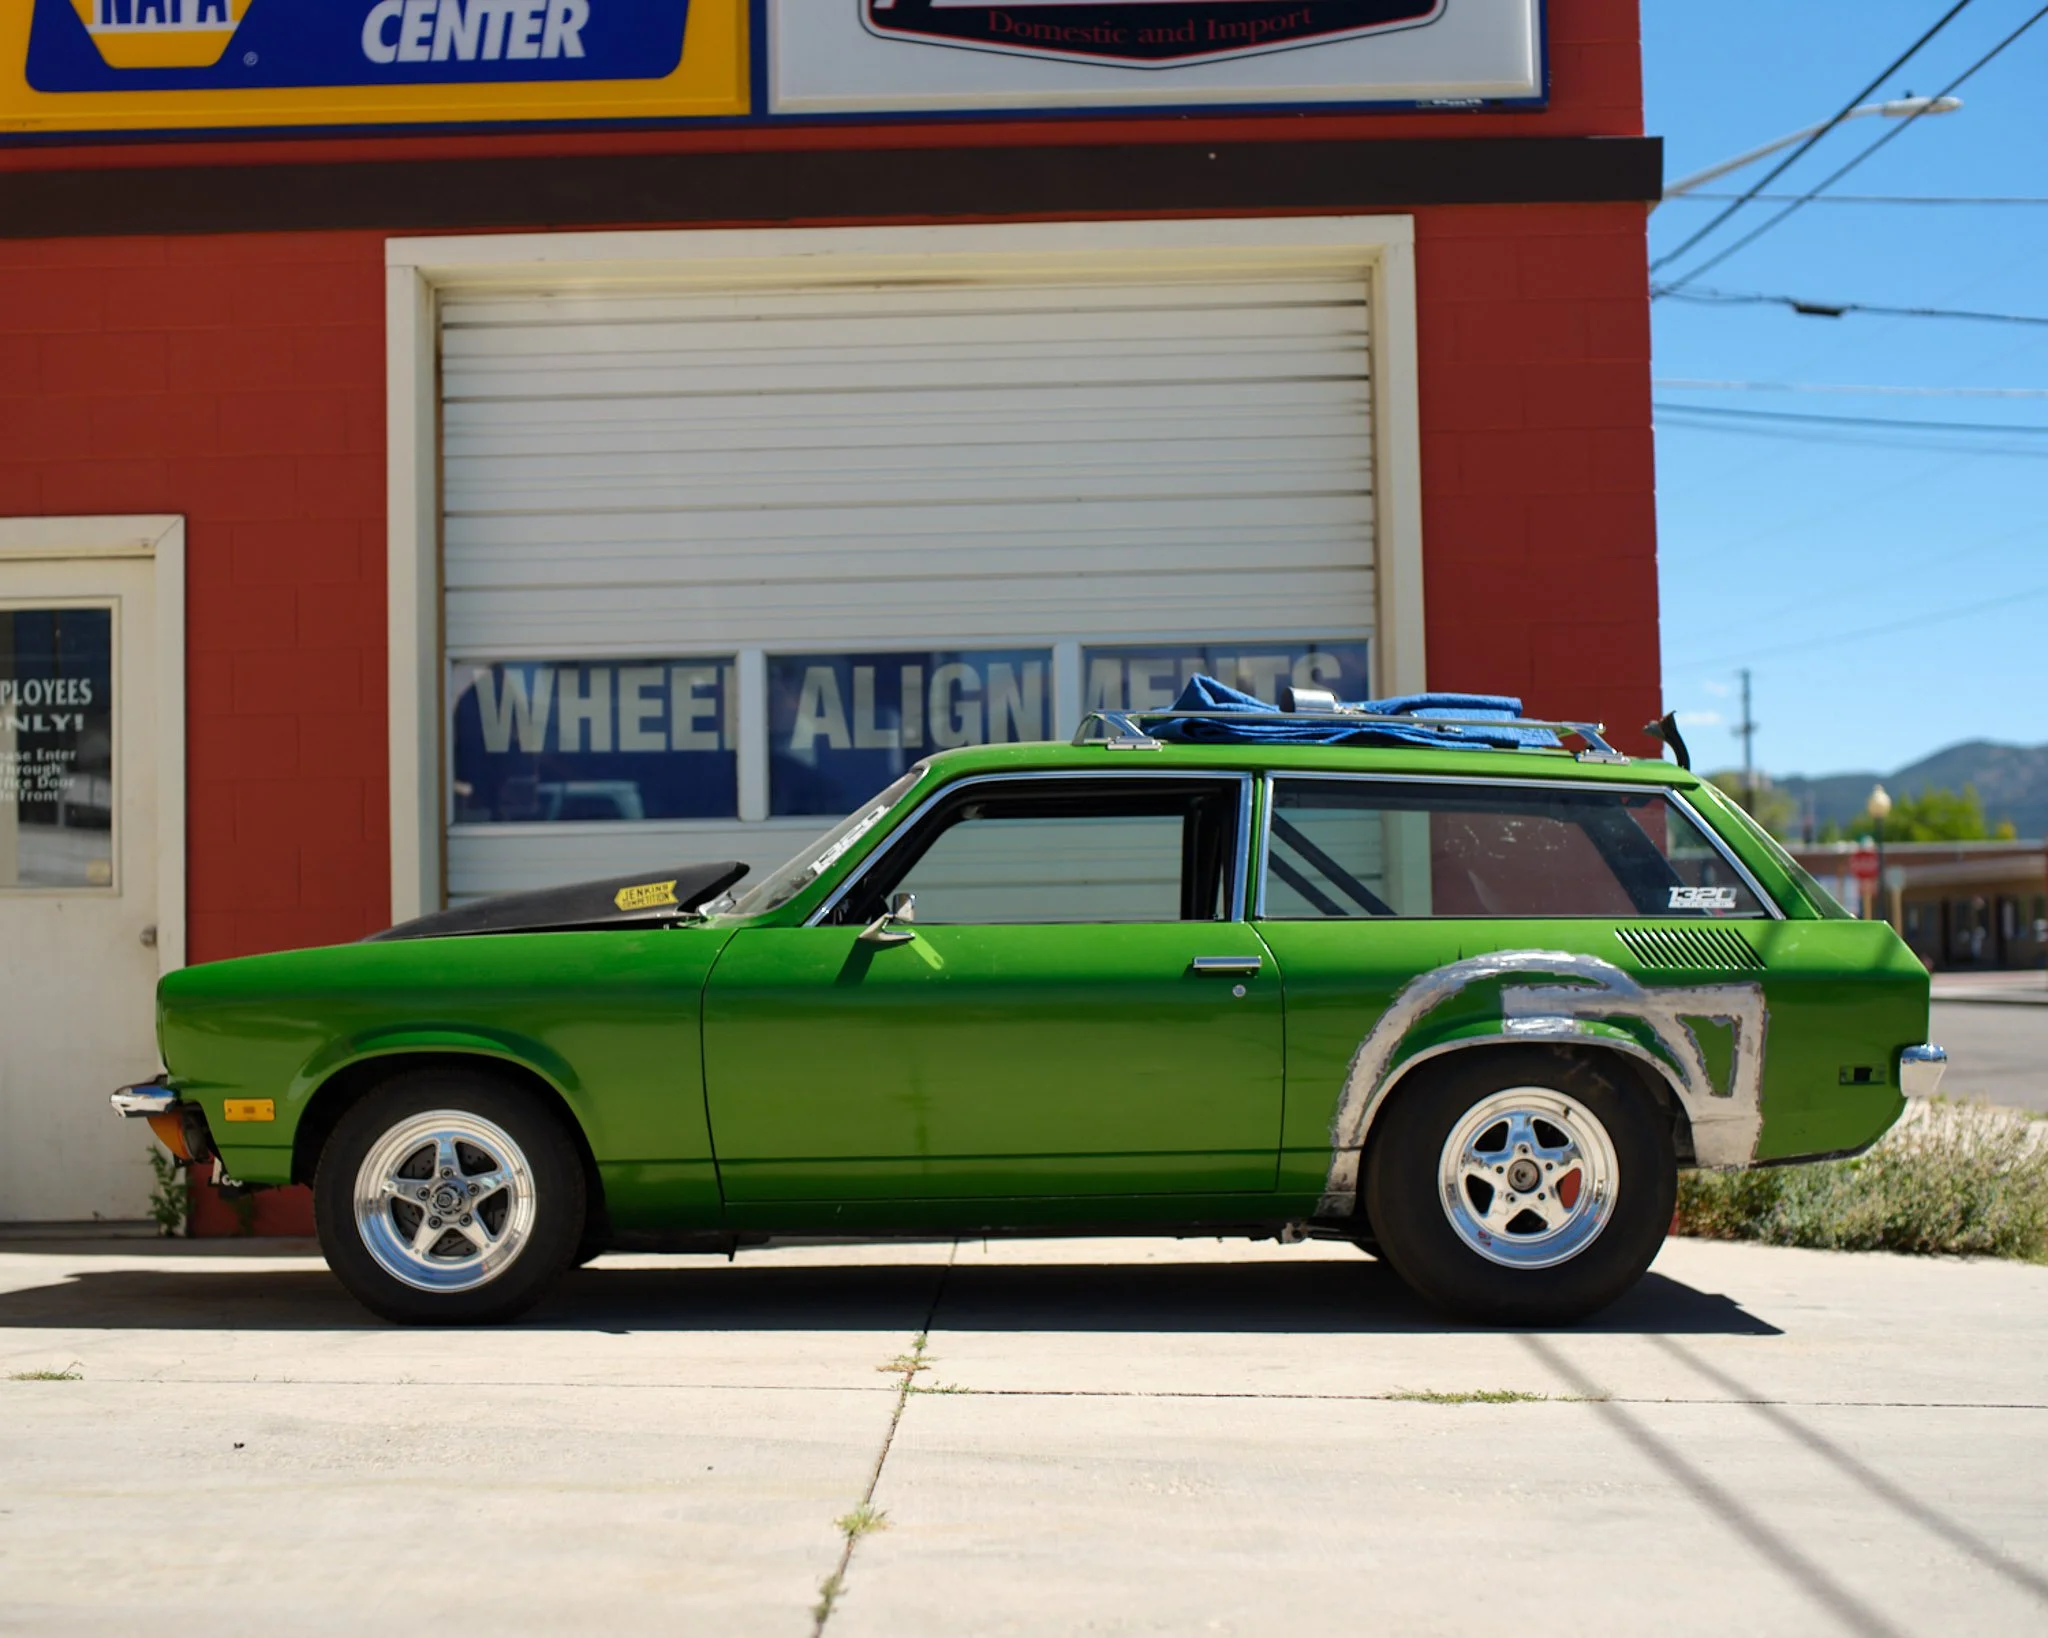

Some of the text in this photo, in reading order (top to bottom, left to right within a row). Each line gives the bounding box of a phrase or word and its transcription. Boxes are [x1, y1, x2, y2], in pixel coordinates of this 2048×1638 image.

[360, 0, 591, 64] CENTER
[987, 7, 1313, 45] Domestic and Import
[0, 713, 84, 733] NLY!
[36, 748, 77, 761] Enter
[37, 775, 75, 791] Door
[1669, 886, 1738, 902] 1320
